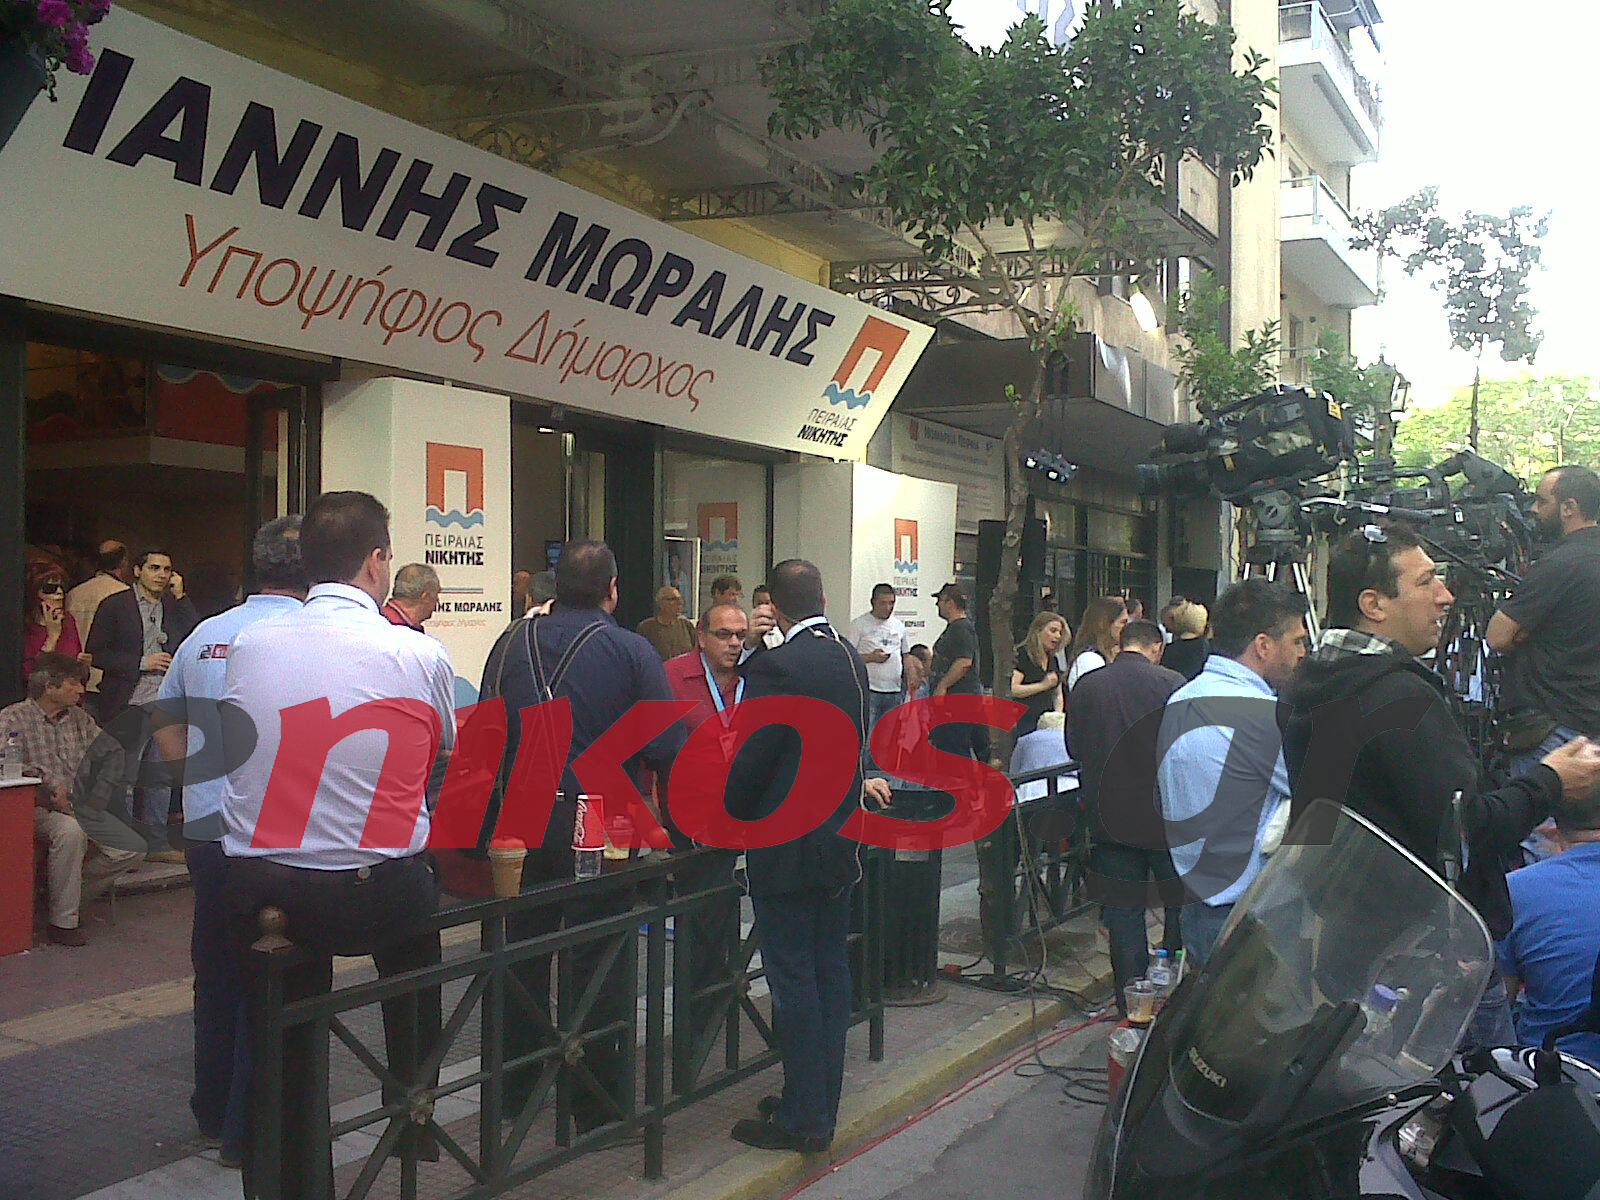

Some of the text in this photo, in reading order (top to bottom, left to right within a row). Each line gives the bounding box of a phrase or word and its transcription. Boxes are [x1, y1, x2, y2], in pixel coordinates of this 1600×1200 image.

[525, 211, 835, 366] ΜΩΡΑΛΗΣ
[179, 214, 715, 413] Υποψήφιος Δήμαρχος
[808, 408, 858, 431] ΠΕΙΡΑΙΑΣ
[797, 424, 849, 447] ΝΙΚΗΤΗΣ
[424, 533, 484, 549] ΠΕΙΡΑΙΑΣ
[425, 550, 484, 566] ΝΙΚΗΤΗΣ
[454, 602, 503, 613] ΜΩΡΑΛΗΣ
[1188, 1046, 1228, 1088] SUZUKI
